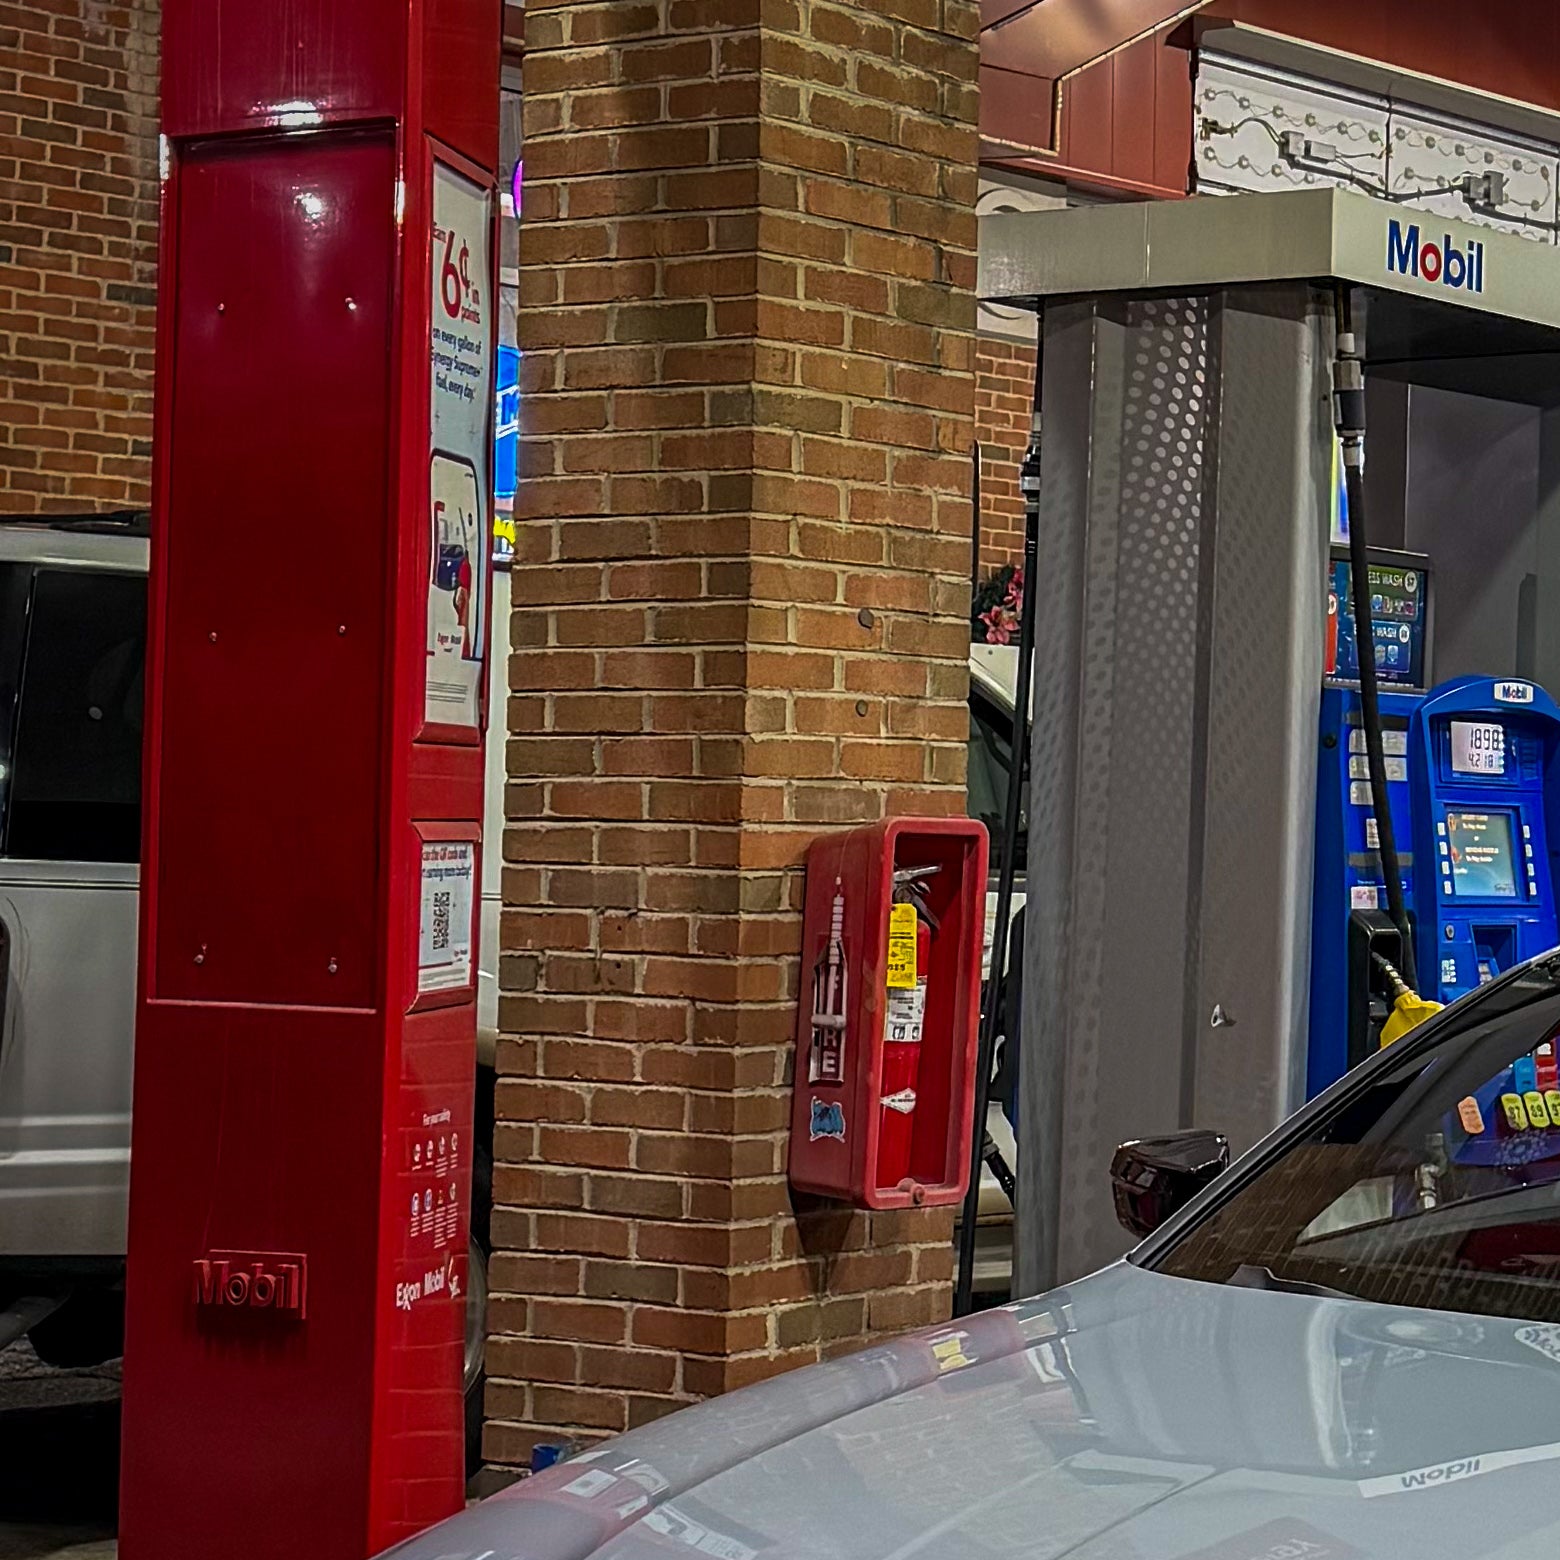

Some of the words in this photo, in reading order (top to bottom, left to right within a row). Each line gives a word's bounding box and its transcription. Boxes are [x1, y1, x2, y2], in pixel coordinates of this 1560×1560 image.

[1387, 218, 1483, 293] Mobil
[192, 1259, 299, 1309] Mobil
[396, 1282, 421, 1310] Exxon
[424, 1266, 445, 1296] Mobil
